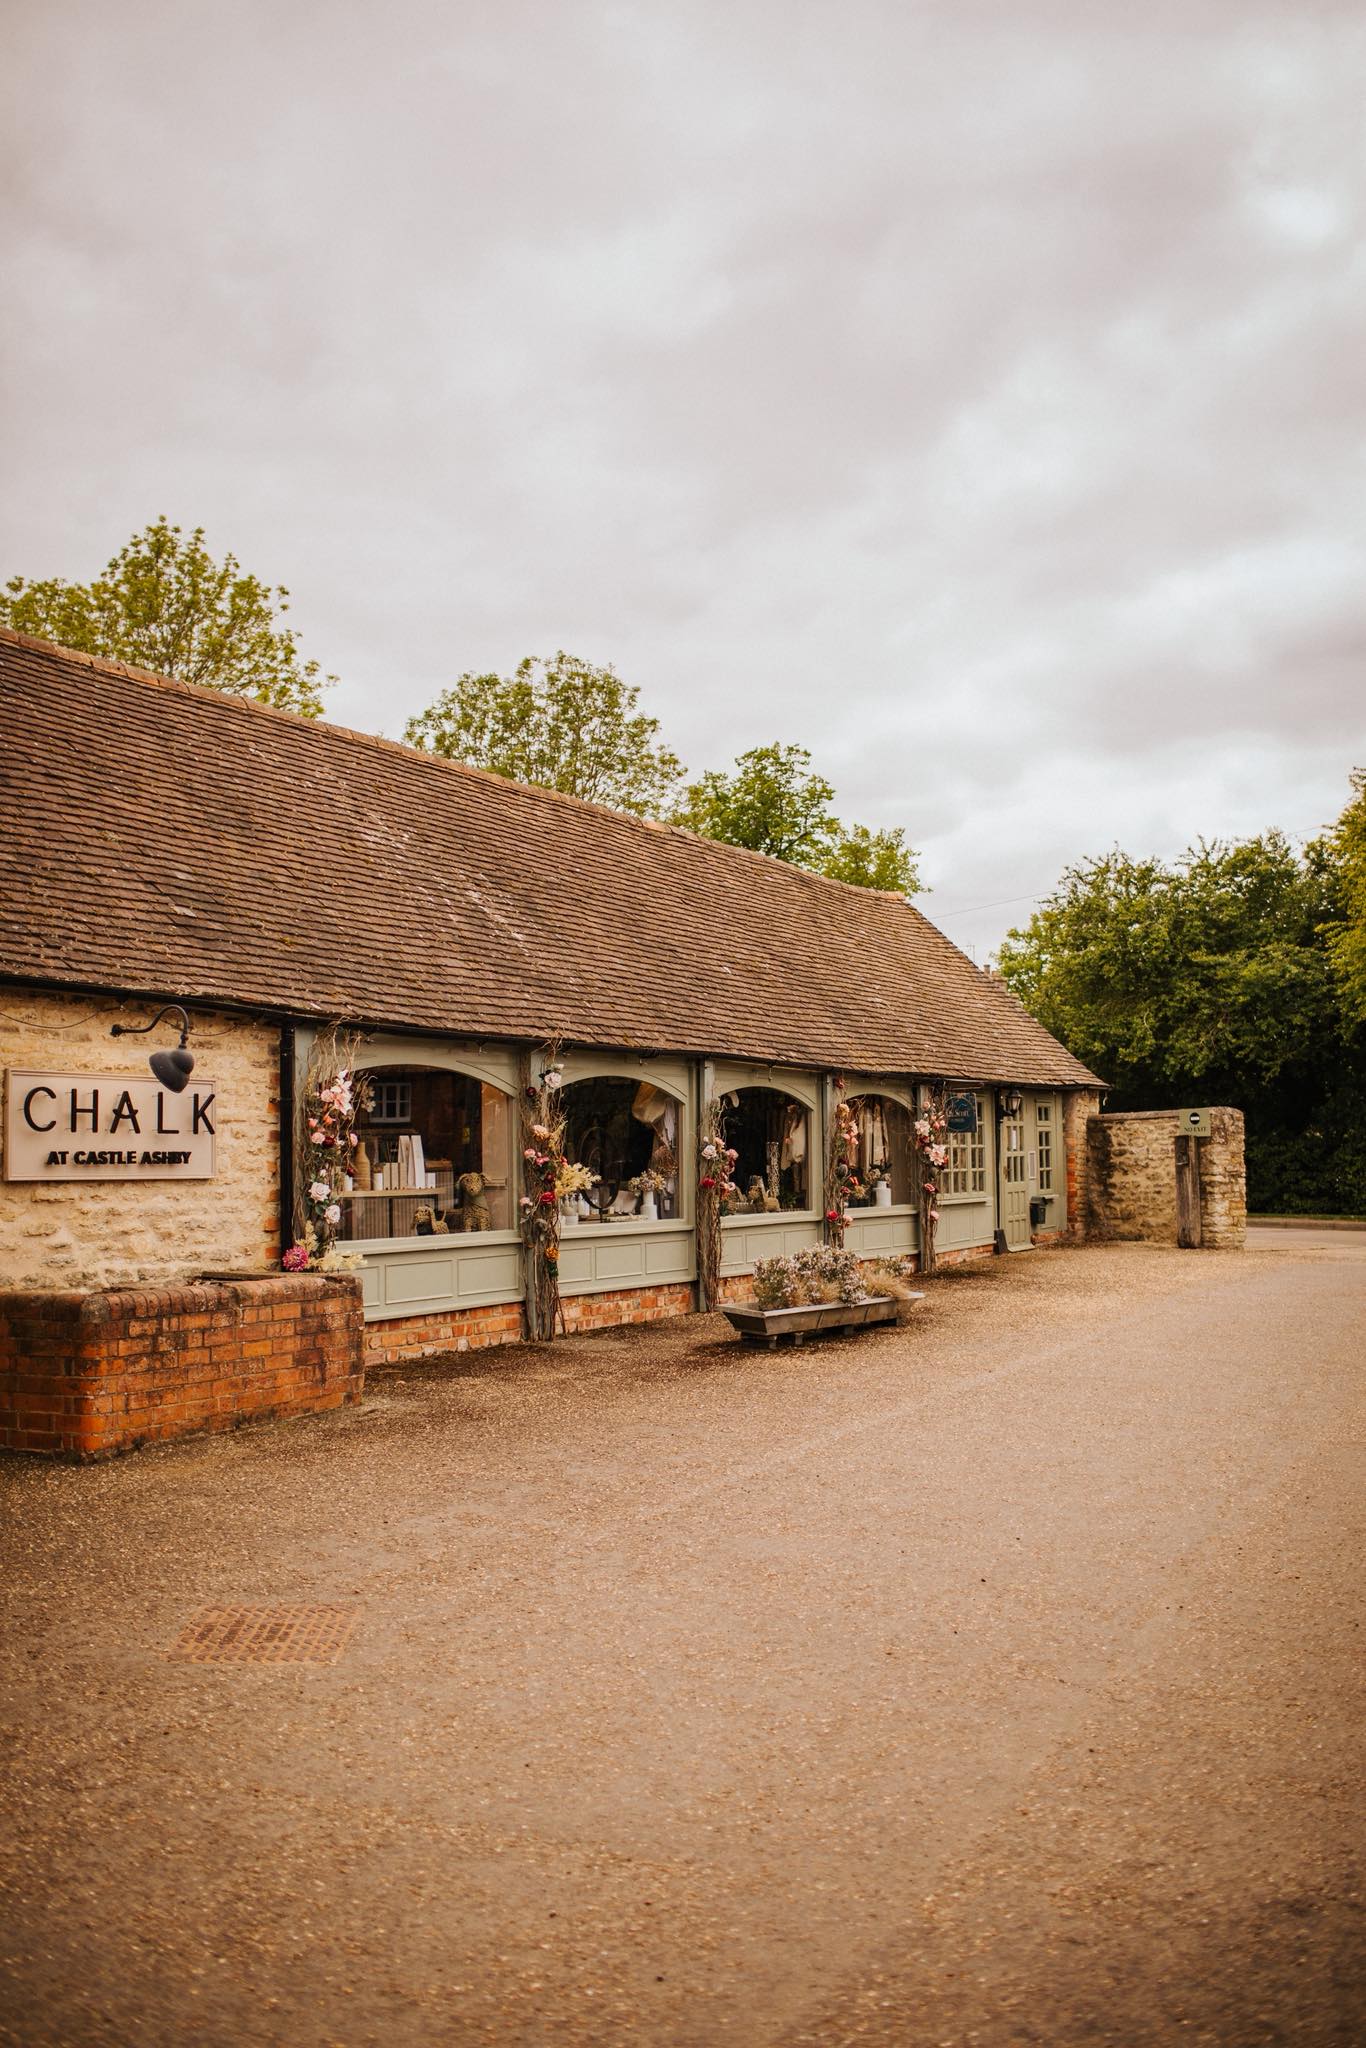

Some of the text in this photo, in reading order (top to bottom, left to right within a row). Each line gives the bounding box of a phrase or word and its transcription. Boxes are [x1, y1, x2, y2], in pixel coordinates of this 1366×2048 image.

[23, 1086, 215, 1134] CHALK
[47, 1151, 192, 1165] AT CASTLE ASHBY
